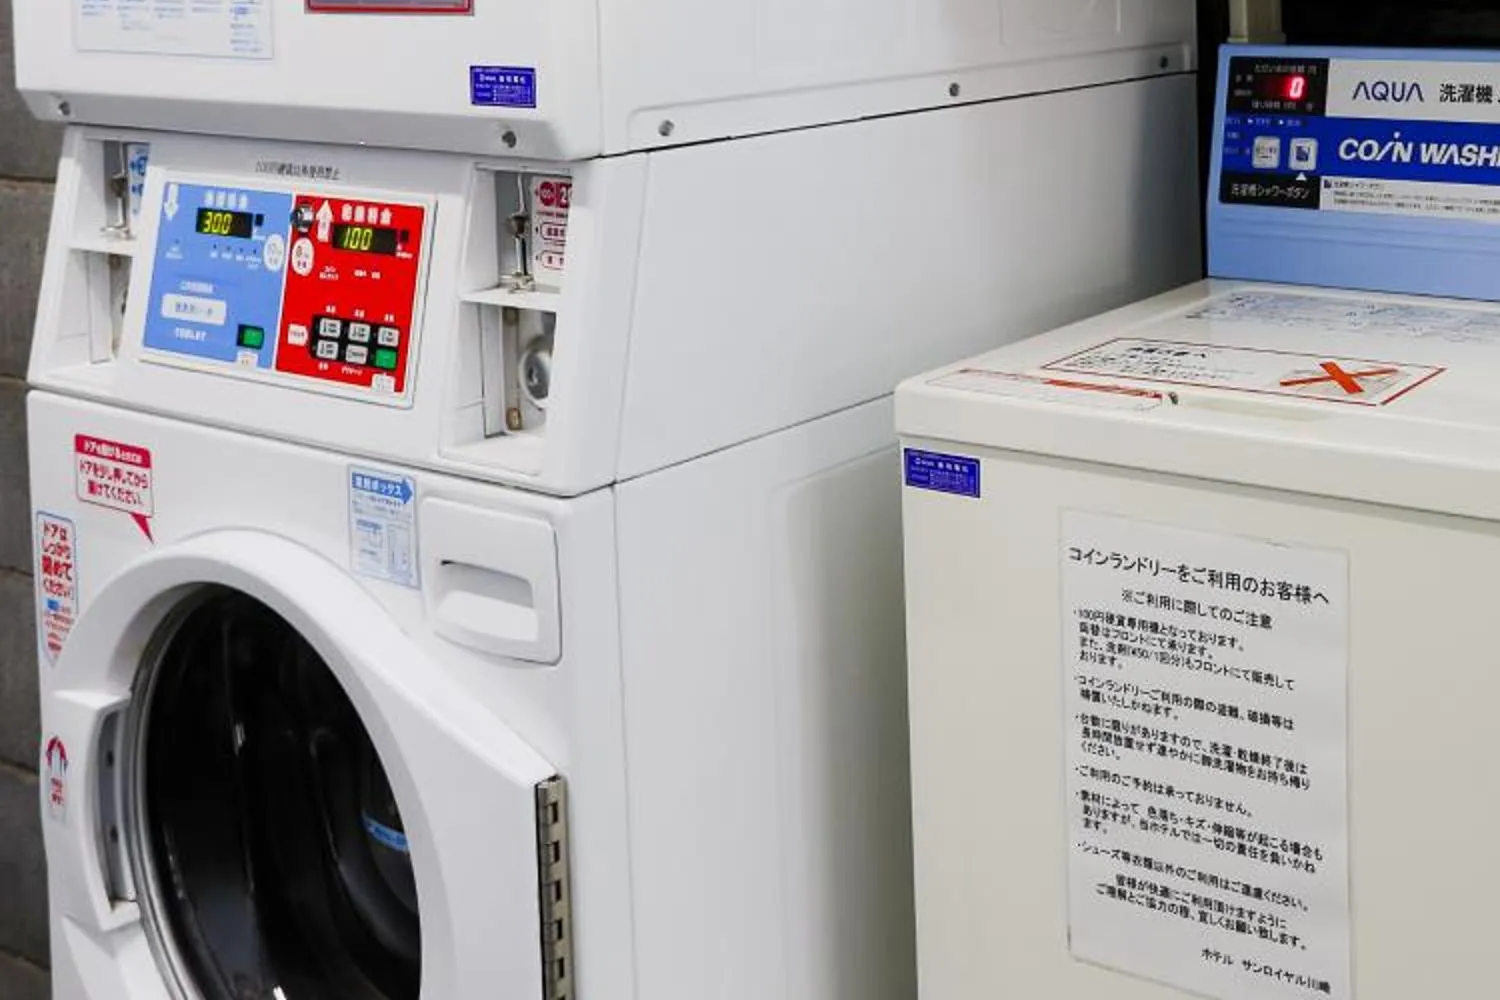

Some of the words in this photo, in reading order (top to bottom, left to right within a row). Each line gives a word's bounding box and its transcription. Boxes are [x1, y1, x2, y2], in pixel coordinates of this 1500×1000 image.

[1353, 81, 1424, 102] AQUA
[1439, 83, 1493, 105] 洗濯機
[1339, 131, 1413, 164] COIN
[203, 211, 233, 235] 300
[343, 226, 374, 251] 100
[1069, 546, 1329, 605] コインランドリーをご利用のお客様へ
